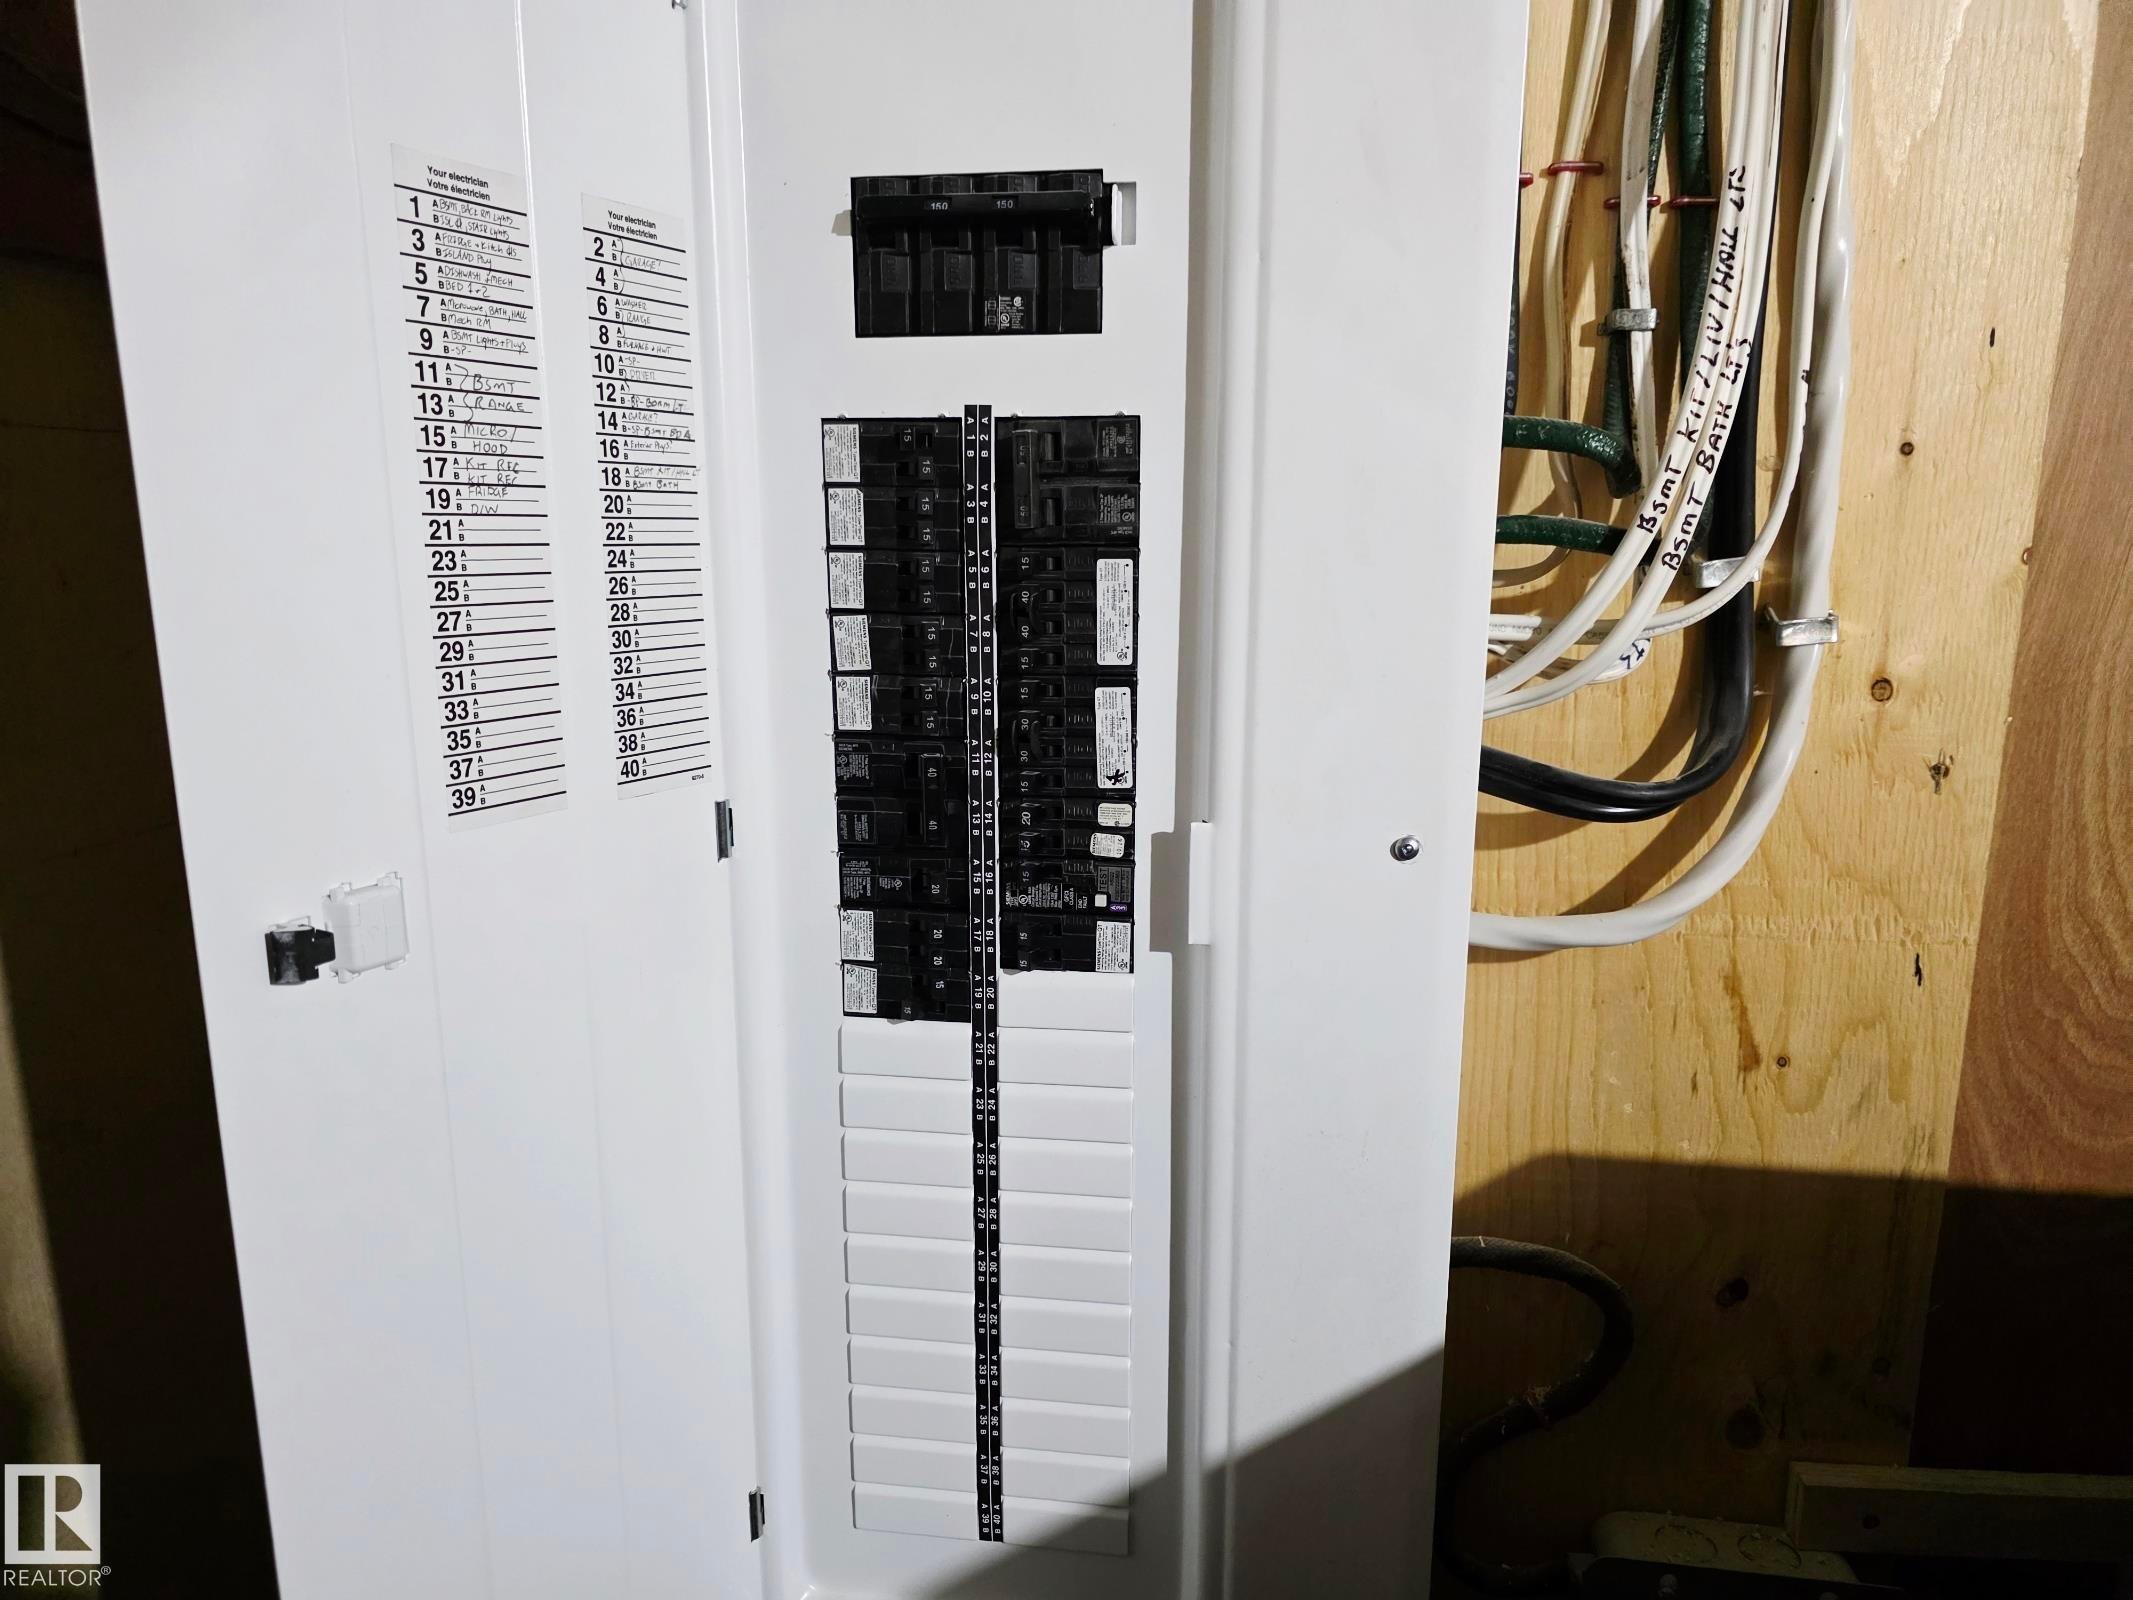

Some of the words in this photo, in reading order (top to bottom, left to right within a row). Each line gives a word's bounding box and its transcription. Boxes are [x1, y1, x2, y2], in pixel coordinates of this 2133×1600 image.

[427, 165, 447, 177] Your
[449, 172, 488, 188] electrician
[427, 179, 448, 192] Votre
[451, 184, 490, 201] électricien
[410, 196, 419, 217] 1
[997, 200, 1013, 208] 150
[608, 210, 623, 221] Your
[625, 216, 656, 229] electrician
[608, 221, 624, 232] Votre
[626, 226, 657, 240] électricien
[412, 229, 425, 251] 3
[594, 237, 604, 257] 2
[415, 262, 427, 284] 5
[596, 267, 606, 286] 4
[446, 281, 463, 291] BED
[482, 286, 490, 298] 2
[417, 295, 429, 317] 7
[597, 296, 607, 315] 6
[420, 328, 432, 350] 9
[599, 325, 609, 344] 8
[415, 360, 437, 382] 11
[595, 353, 614, 373] 10
[597, 382, 616, 402] 12
[417, 393, 443, 415] 13
[598, 411, 618, 430] 14
[420, 425, 445, 446] 15
[904, 428, 911, 442] 15
[1696, 400, 1735, 474] BATH
[473, 441, 508, 455] HOOD
[600, 439, 619, 458] 16
[423, 457, 447, 478] 17
[923, 460, 930, 474] 15
[602, 467, 621, 486] 18
[426, 488, 450, 509] 19
[468, 486, 509, 497] FRIDGE
[604, 495, 623, 513] 20
[922, 497, 930, 510] 15
[429, 520, 451, 540] 21
[606, 523, 625, 540] 22
[923, 528, 931, 541] 15
[432, 550, 456, 571] 23
[608, 550, 627, 568] 24
[1022, 557, 1029, 570] 15
[434, 581, 459, 601] 25
[609, 577, 628, 594] 26
[1022, 591, 1029, 604] 40
[611, 603, 630, 621] 28
[437, 611, 461, 632] 27
[612, 630, 631, 648] 30
[928, 627, 936, 640] 15
[440, 641, 463, 662] 29
[614, 656, 633, 675] 32
[1021, 656, 1029, 669] 15
[442, 671, 464, 692] 31
[616, 683, 634, 701] 34
[983, 691, 991, 702] 10
[445, 700, 469, 721] 33
[617, 708, 636, 727] 36
[926, 716, 934, 729] 15
[1022, 718, 1029, 731] 30
[447, 729, 471, 751] 35
[619, 734, 637, 753] 38
[972, 753, 980, 762] 11
[984, 753, 992, 763] 12
[1021, 751, 1028, 762] 30
[450, 758, 473, 780] 37
[621, 760, 639, 778] 40
[928, 768, 937, 777] 40
[452, 787, 476, 808] 39
[973, 813, 980, 823] 13
[985, 813, 992, 823] 14
[1022, 811, 1031, 825] 20
[974, 873, 981, 882] 15
[986, 872, 993, 882] 16
[1023, 871, 1029, 882] 15
[1100, 869, 1108, 890] TEST
[932, 884, 940, 894] 20
[934, 930, 942, 938] 20
[974, 931, 981, 941] 17
[986, 930, 993, 940] 18
[934, 956, 942, 965] 20
[975, 988, 982, 998] 19
[987, 988, 994, 998] 20
[976, 1043, 983, 1053] 21
[988, 1044, 995, 1054] 22
[989, 1154, 996, 1165] 26
[990, 1262, 997, 1272] 30
[980, 1415, 987, 1425] 35
[982, 1514, 989, 1523] 39
